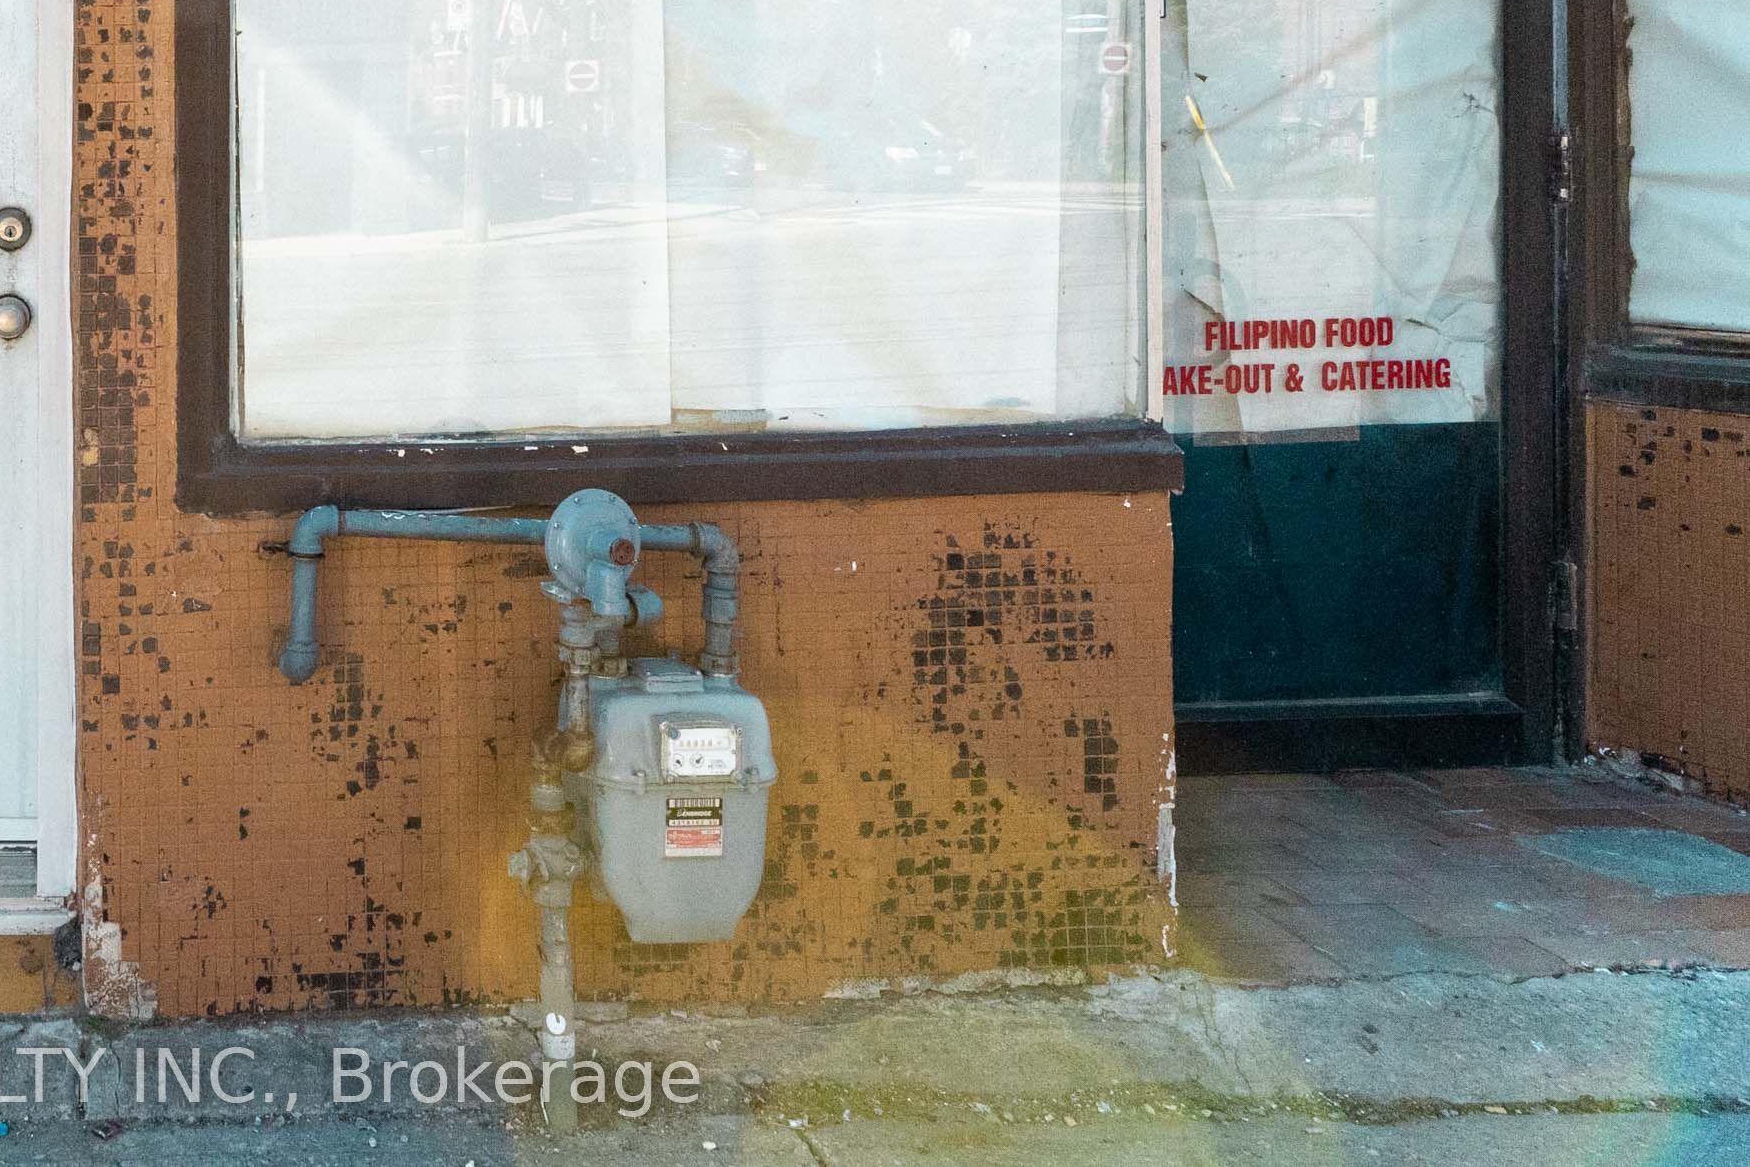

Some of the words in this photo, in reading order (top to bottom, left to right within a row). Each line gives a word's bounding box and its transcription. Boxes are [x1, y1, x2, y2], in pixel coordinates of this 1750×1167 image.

[1205, 320, 1316, 351] FILIPINO
[1325, 316, 1394, 347] FOOD
[1162, 364, 1275, 395] AKE-OUT
[1284, 364, 1305, 393] &
[1321, 358, 1451, 392] CATERING
